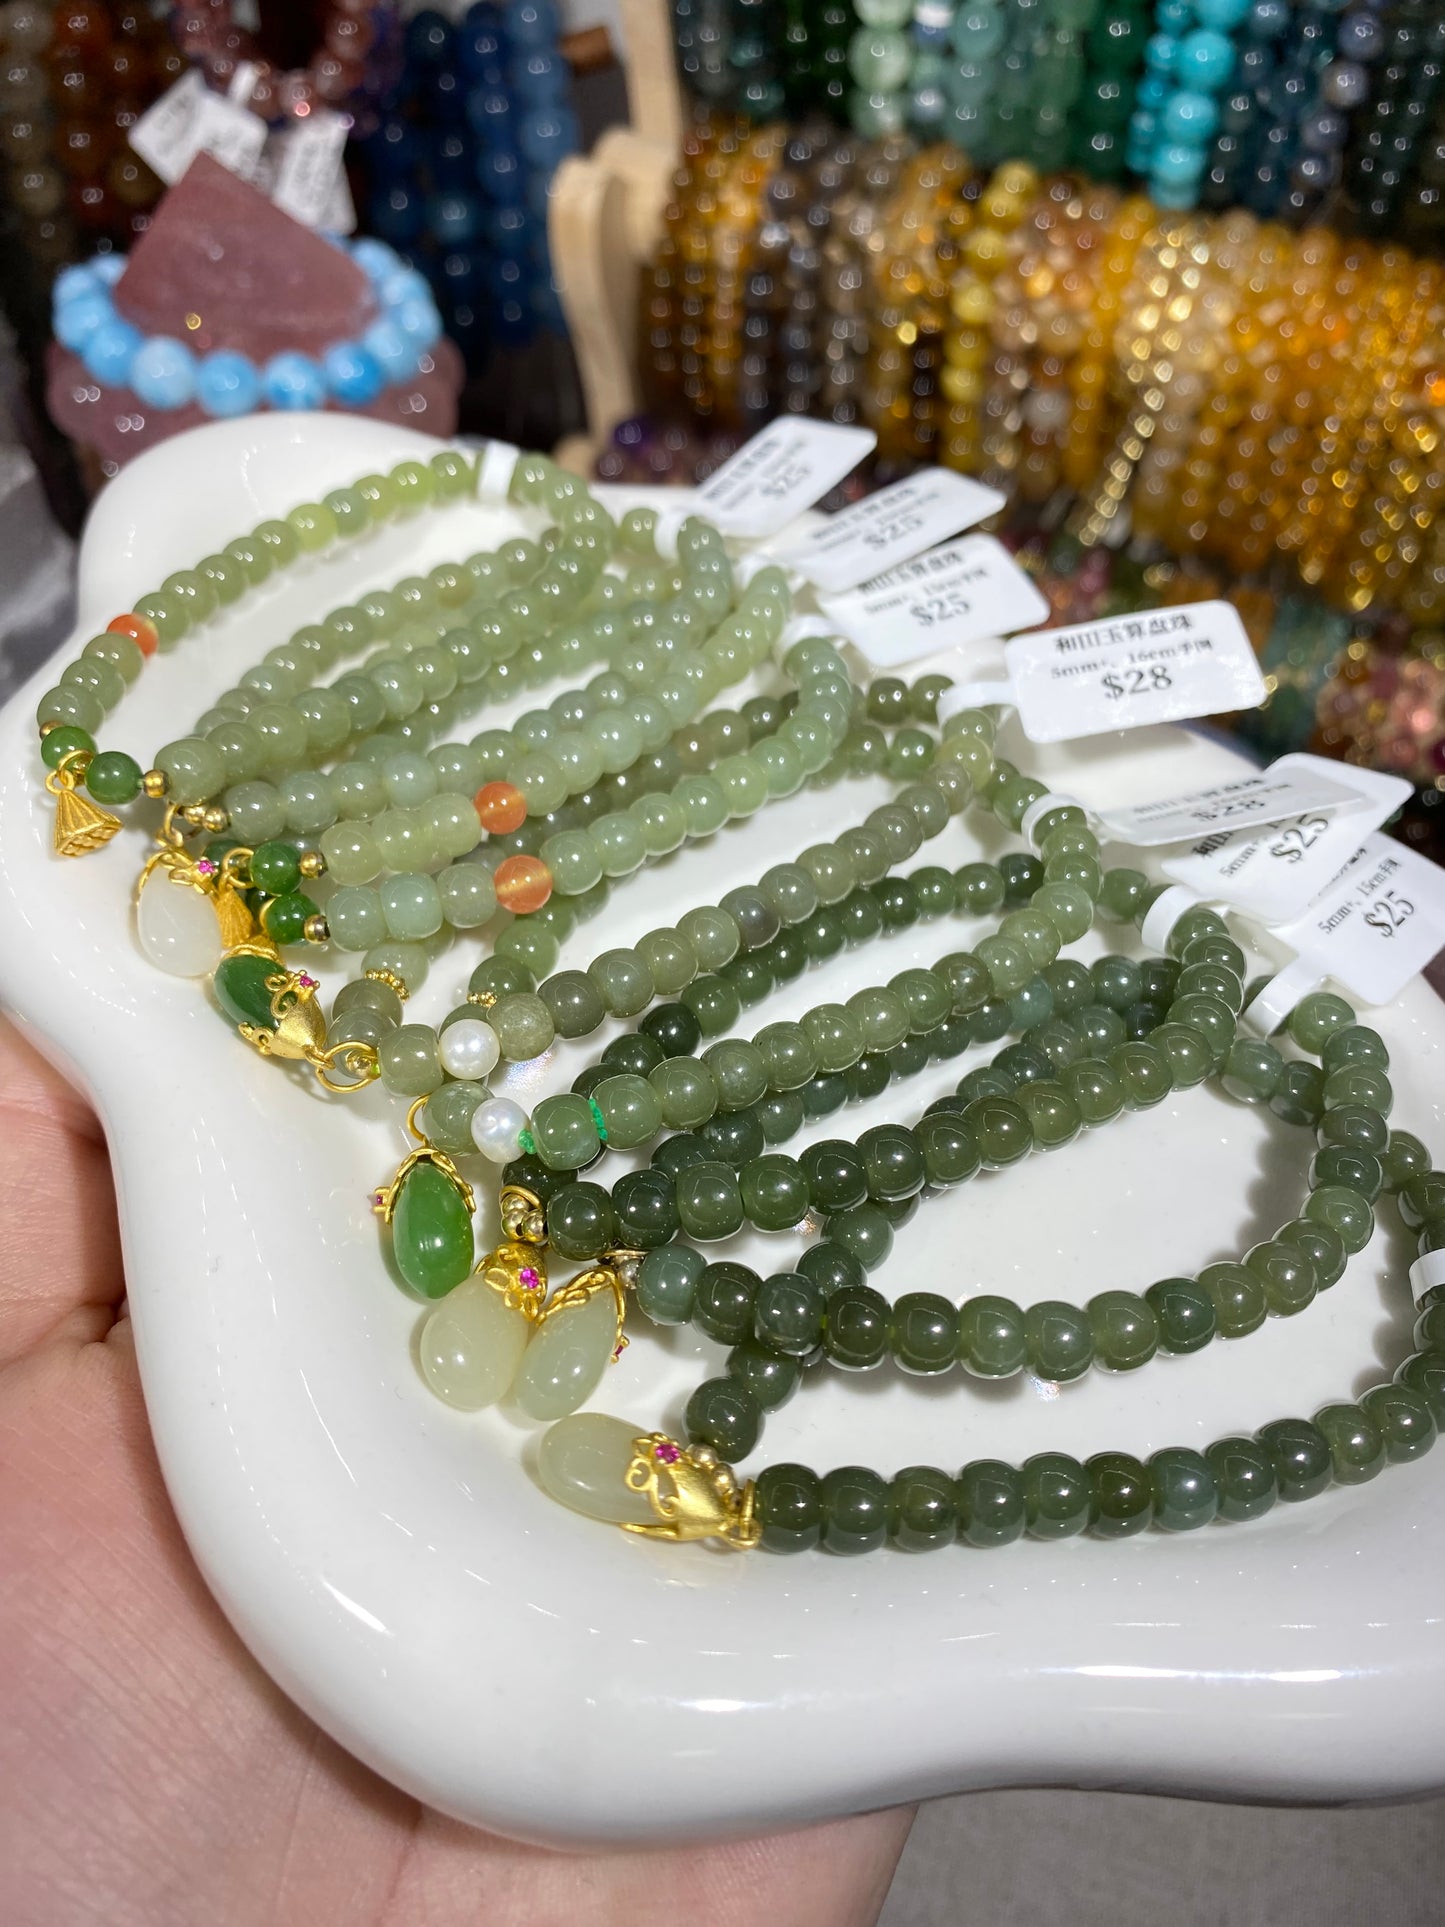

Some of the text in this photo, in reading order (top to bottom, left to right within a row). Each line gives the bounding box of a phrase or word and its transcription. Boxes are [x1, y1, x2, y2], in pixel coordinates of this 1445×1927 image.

[910, 592, 971, 627] $25
[1101, 664, 1173, 700] $28
[1270, 813, 1329, 864] $25
[1364, 890, 1415, 939] $25
